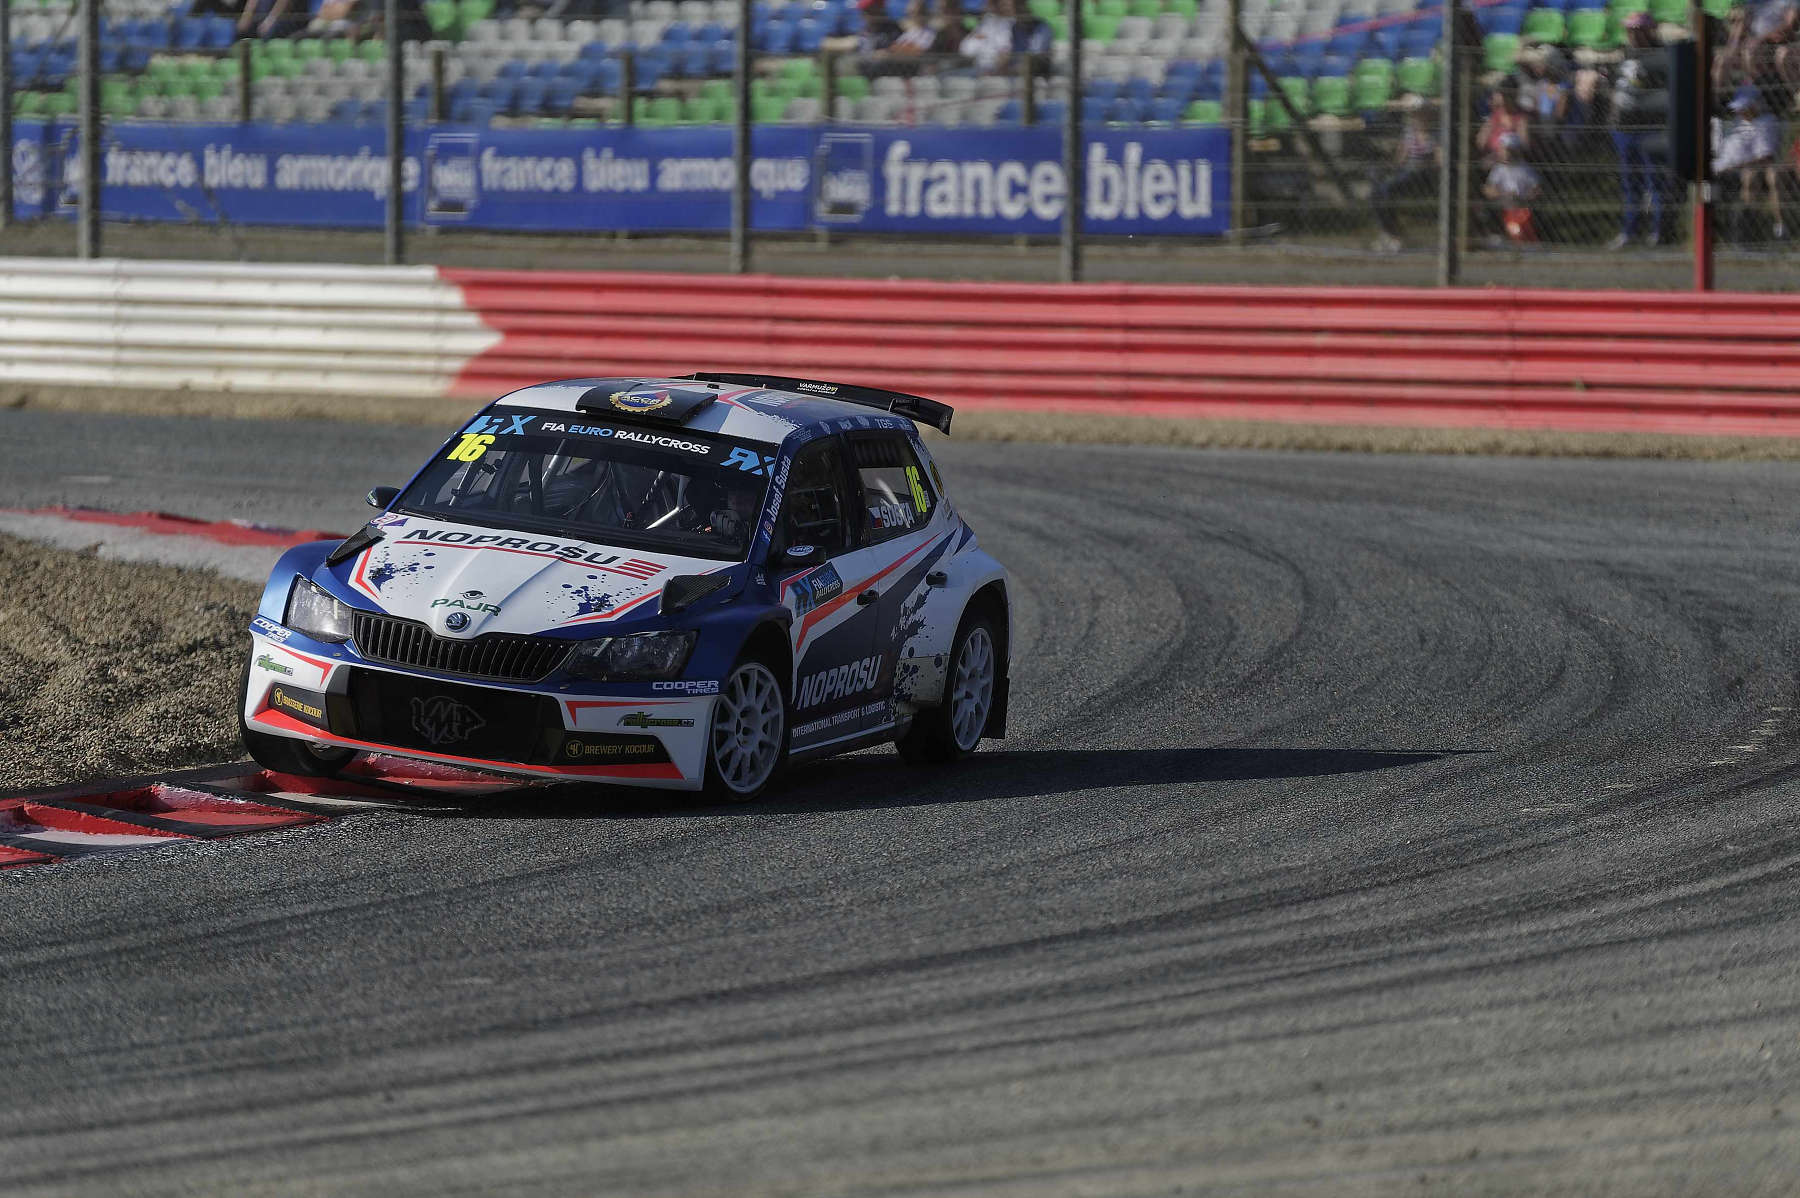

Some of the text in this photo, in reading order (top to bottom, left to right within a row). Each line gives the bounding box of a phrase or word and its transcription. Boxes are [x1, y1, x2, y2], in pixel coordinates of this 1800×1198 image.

[104, 143, 197, 188] france
[203, 143, 267, 188] bleu
[274, 145, 421, 200] armoriqe
[480, 147, 576, 192] france
[582, 147, 650, 192] bleu
[656, 157, 810, 199] armoque
[884, 139, 1067, 220] france
[1086, 141, 1213, 220] bleu
[446, 433, 496, 462] 16
[541, 422, 711, 455] FIA EURO RALLYCROSS
[905, 465, 927, 513] 16
[402, 529, 621, 566] NOPROSU
[252, 618, 293, 639] COOPER
[652, 680, 719, 690] COOPER
[796, 654, 883, 711] NOPROSU
[584, 745, 623, 755] BREWERY
[625, 743, 655, 753] KOCOUR
